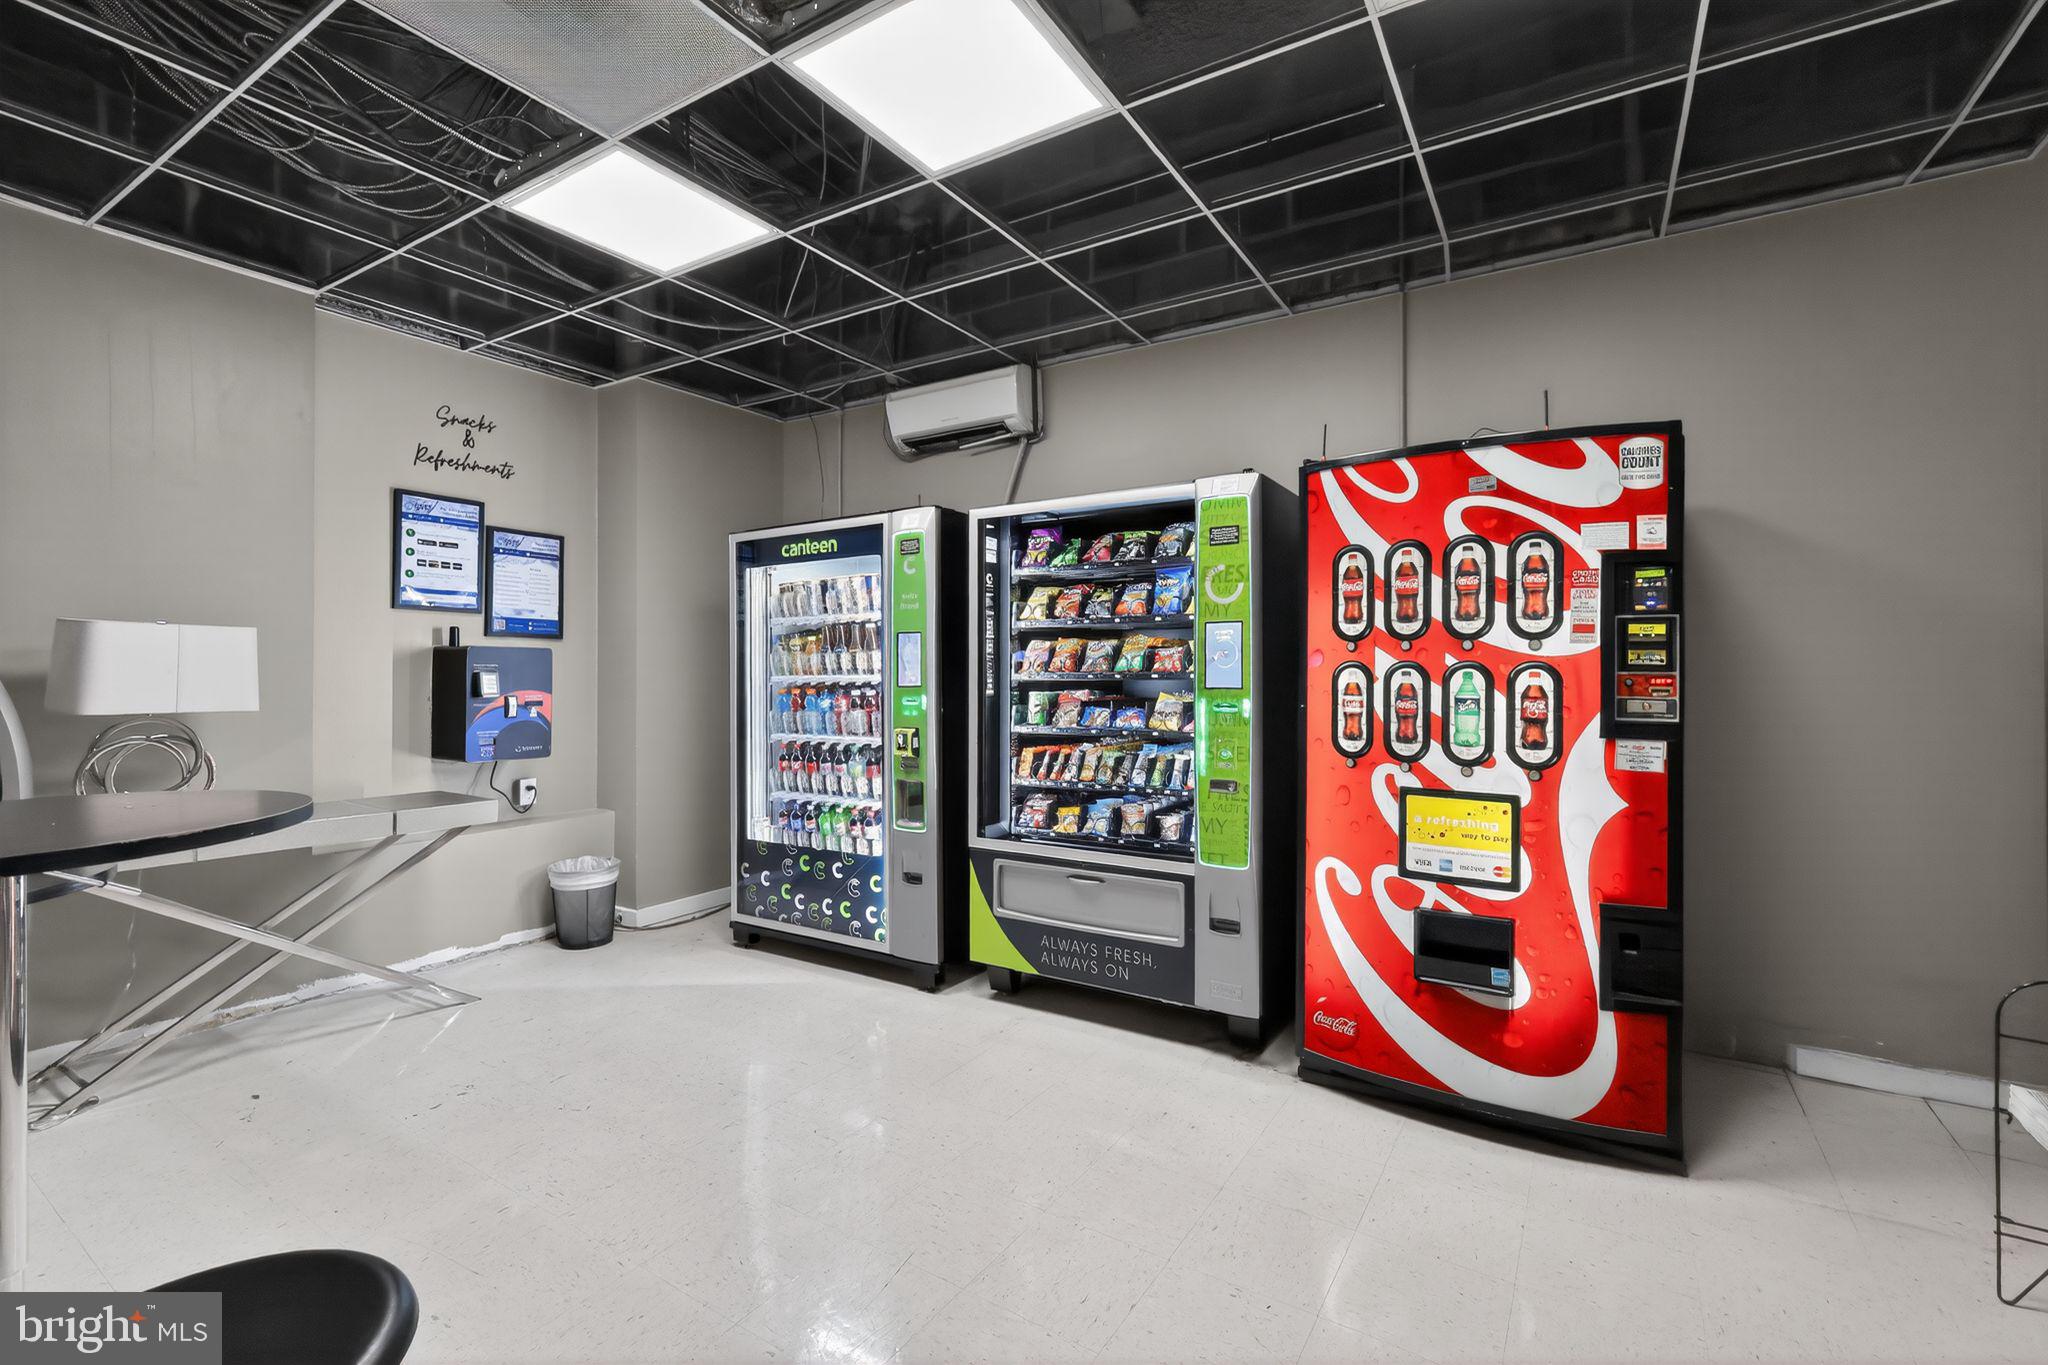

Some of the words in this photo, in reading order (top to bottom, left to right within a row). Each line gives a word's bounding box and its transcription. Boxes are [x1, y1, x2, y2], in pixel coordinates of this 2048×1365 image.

[436, 405, 497, 433] Snacks
[462, 429, 475, 448] &
[413, 442, 516, 480] Refreshments
[1621, 455, 1661, 469] COUNT
[781, 538, 838, 558] canteen
[1426, 816, 1499, 832] refreshing
[1040, 935, 1098, 958] ALWAYS
[1105, 946, 1158, 969] FRESH,
[1041, 951, 1098, 974] ALWAYS
[1105, 963, 1130, 980] ON
